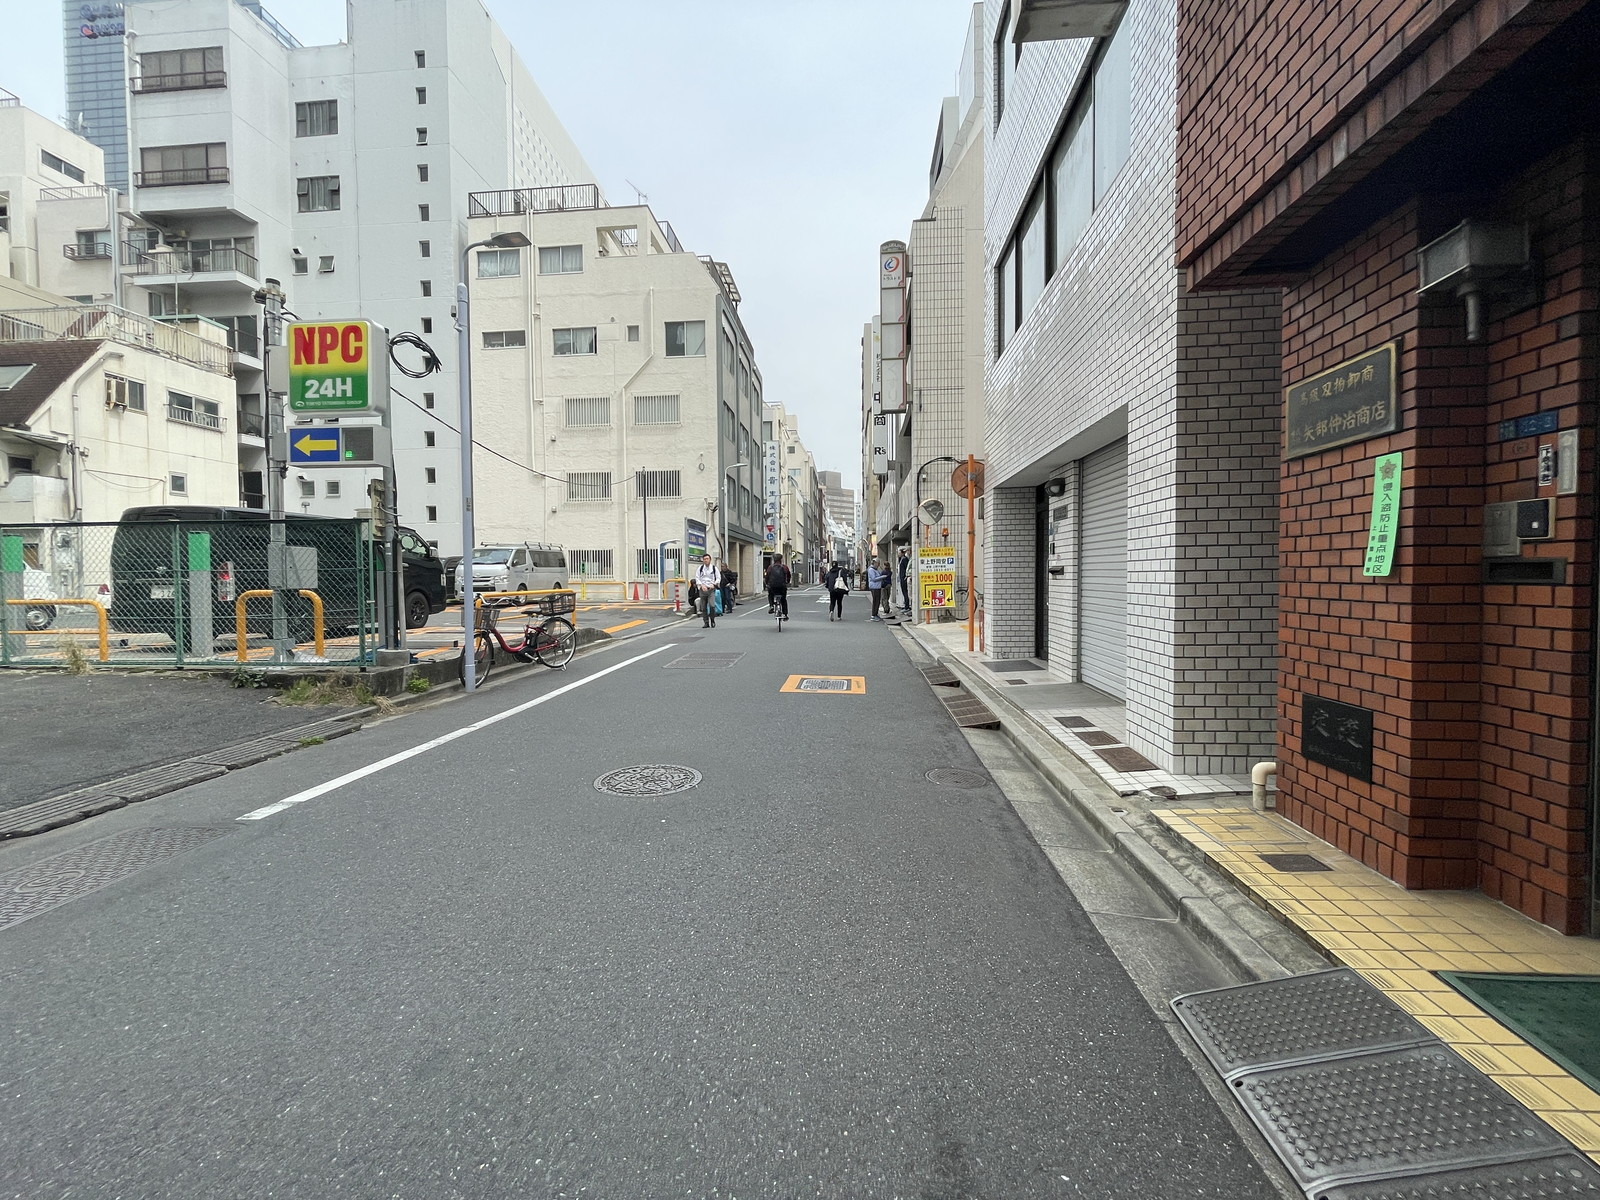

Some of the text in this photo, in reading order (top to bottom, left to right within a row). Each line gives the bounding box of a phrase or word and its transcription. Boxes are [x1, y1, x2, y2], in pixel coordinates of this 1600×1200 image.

[294, 325, 363, 365] NPC
[305, 377, 353, 399] 24H
[1372, 482, 1393, 574] 侵入盗防止重点地区
[935, 573, 953, 582] 1000
